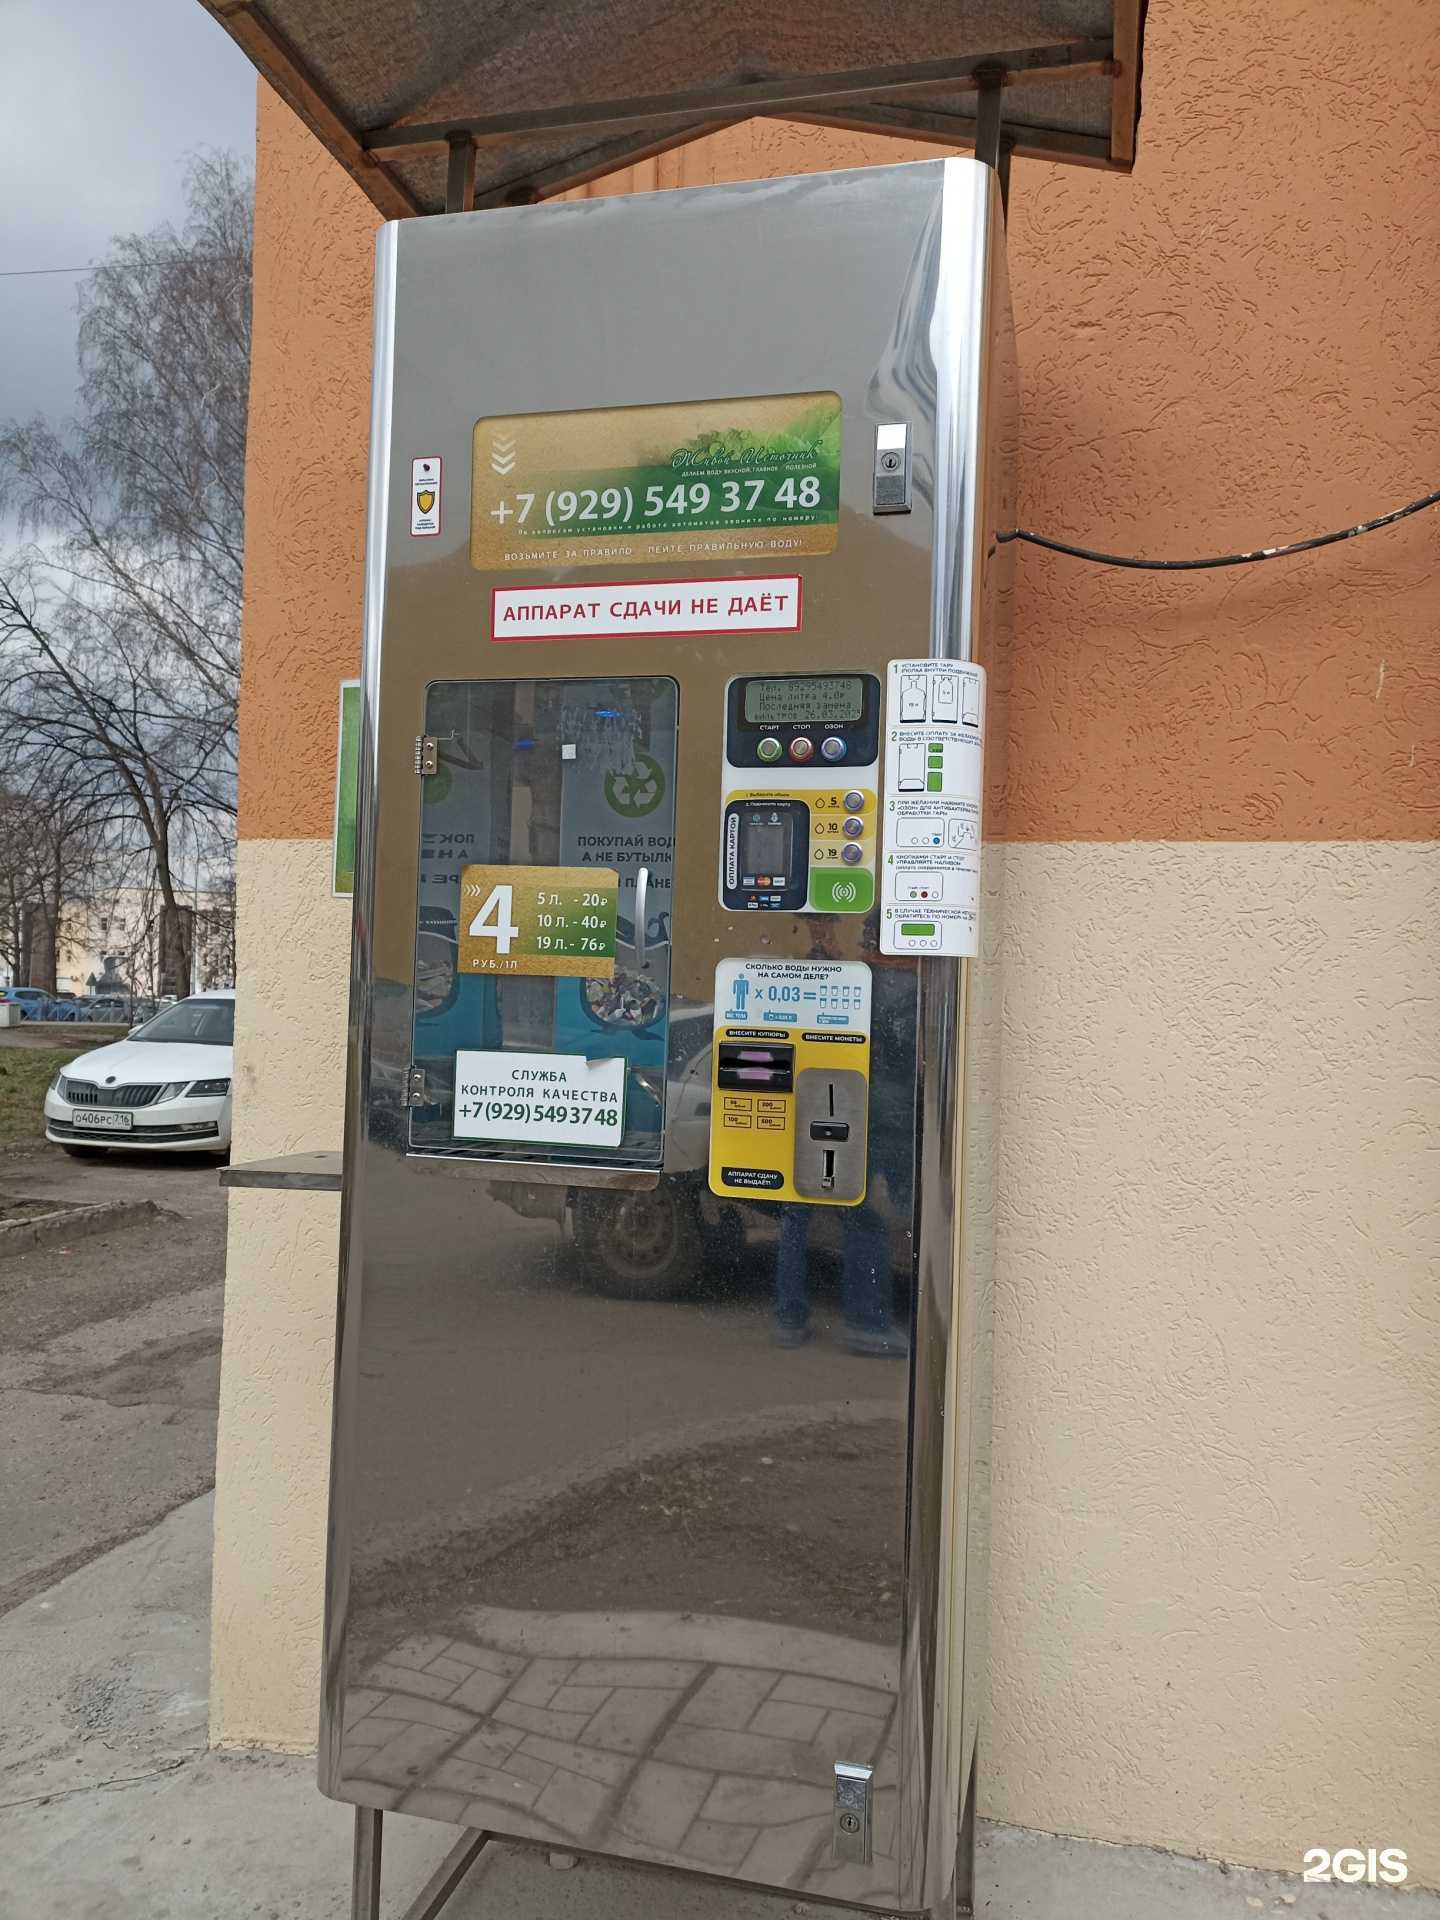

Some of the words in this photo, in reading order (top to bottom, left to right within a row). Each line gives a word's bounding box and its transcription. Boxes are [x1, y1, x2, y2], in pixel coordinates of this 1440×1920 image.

[490, 493, 535, 524] +7
[545, 487, 633, 526] (929)
[644, 483, 711, 516] 549
[720, 480, 765, 512] 37
[774, 476, 821, 509] 48
[504, 551, 558, 561] ВОЗЬМИТЕ
[566, 550, 577, 559] ЗА
[689, 540, 764, 552] ПРАВИЛЬНУЮ
[503, 602, 600, 622] АППАРАТ
[609, 600, 681, 620] СДАЧИ
[691, 598, 718, 615] НЕ
[728, 592, 789, 617] ДАЁТ
[894, 664, 898, 674] 1
[891, 731, 897, 741] 2
[830, 797, 837, 805] 5
[889, 800, 895, 811] 3
[828, 823, 838, 831] 10
[578, 834, 644, 847] ПОКУПАЙ
[582, 852, 591, 861] А
[595, 851, 613, 861] НЕ
[828, 848, 837, 857] 19
[888, 854, 894, 864] 4
[729, 851, 737, 885] ОПЛАТА
[537, 892, 545, 905] 5
[549, 894, 562, 906] Л.
[469, 884, 519, 954] 4
[887, 908, 892, 919] 5
[537, 914, 552, 928] 10
[555, 916, 569, 928] Л.
[536, 936, 551, 949] 19
[554, 938, 567, 950] Л.
[745, 963, 783, 971] СКОЛЬКО
[785, 965, 810, 973] ВОДЫ
[768, 986, 800, 1003] 0,03
[512, 1069, 567, 1083] СЛУЖБА
[461, 1084, 534, 1098] КОНТРОЛЯ
[543, 1089, 618, 1103] КАЧЕСТВА
[728, 1170, 756, 1178] АППАРАТ
